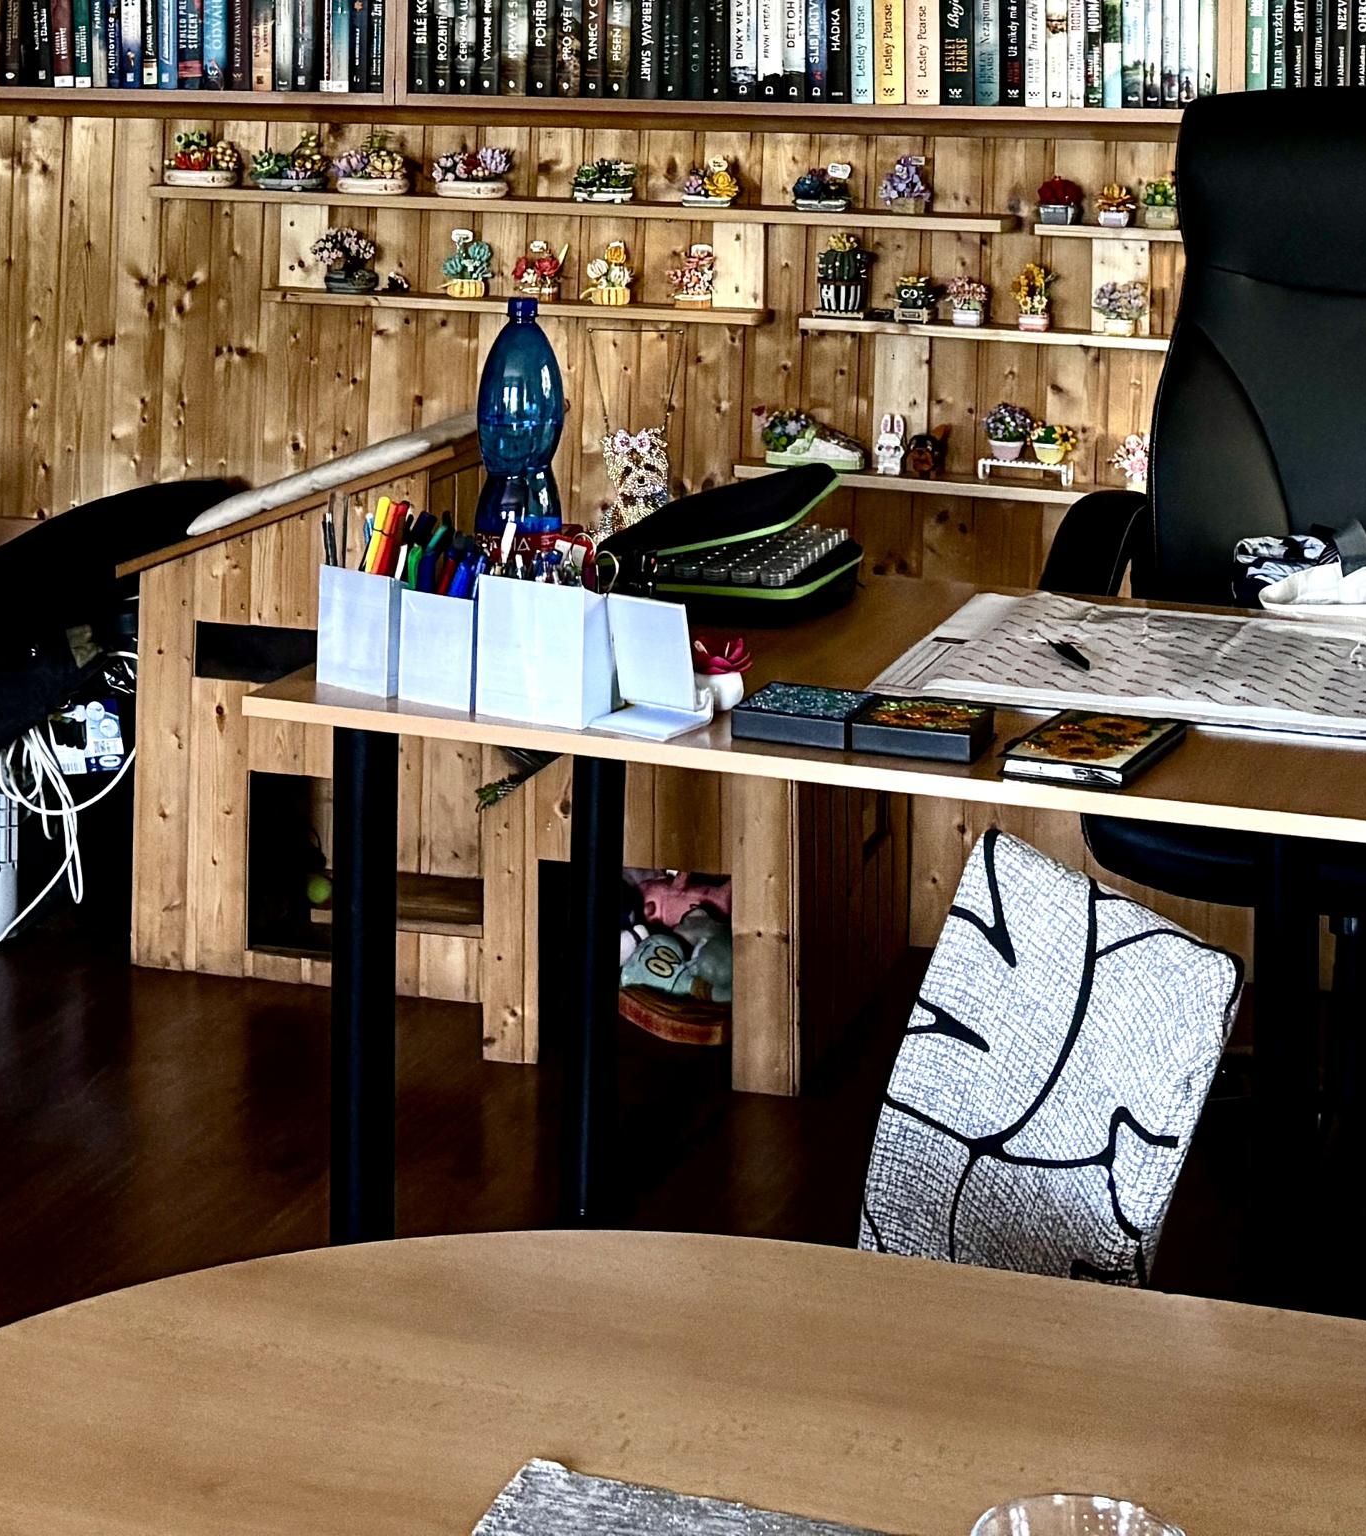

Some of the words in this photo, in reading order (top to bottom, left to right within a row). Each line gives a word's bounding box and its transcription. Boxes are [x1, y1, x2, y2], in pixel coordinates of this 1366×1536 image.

[559, 4, 573, 33] SVĚT
[589, 11, 598, 20] V
[883, 4, 893, 39] Pearse
[1007, 6, 1017, 19] mě
[1271, 4, 1285, 46] vraždu
[413, 18, 427, 44] BÍLÉ
[588, 23, 598, 61] TANEC
[830, 8, 840, 51] HÁDKA
[1007, 21, 1020, 43] nikdy
[560, 37, 573, 60] PRO
[883, 43, 895, 76] Lesley
[1008, 46, 1018, 57] Už
[1275, 49, 1284, 66] na
[641, 50, 651, 81] SMRT
[1272, 68, 1284, 87] hra
